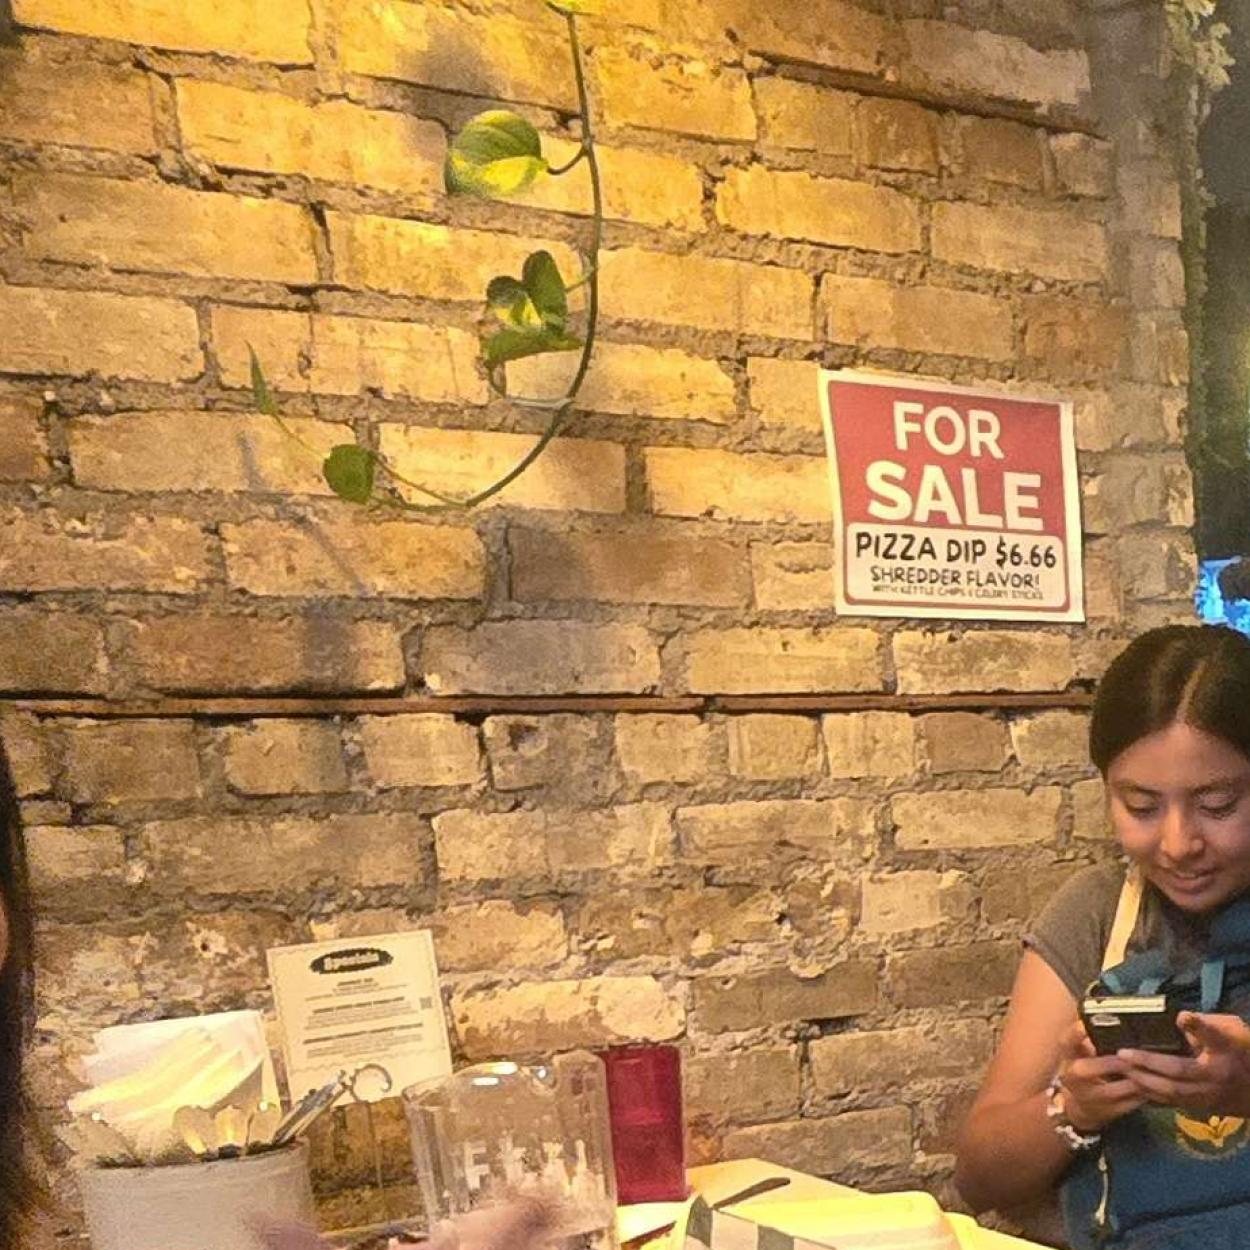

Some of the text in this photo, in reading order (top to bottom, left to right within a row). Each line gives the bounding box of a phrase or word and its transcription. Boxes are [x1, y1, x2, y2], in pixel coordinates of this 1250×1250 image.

[894, 401, 1004, 459] FOR
[865, 460, 1044, 531] SALE
[855, 531, 1057, 569] PIZZA DIP $6.66
[870, 565, 1041, 588] SHREDDER FLAVOR!
[900, 585, 934, 596] KETTLE
[937, 587, 966, 597] CHIPS
